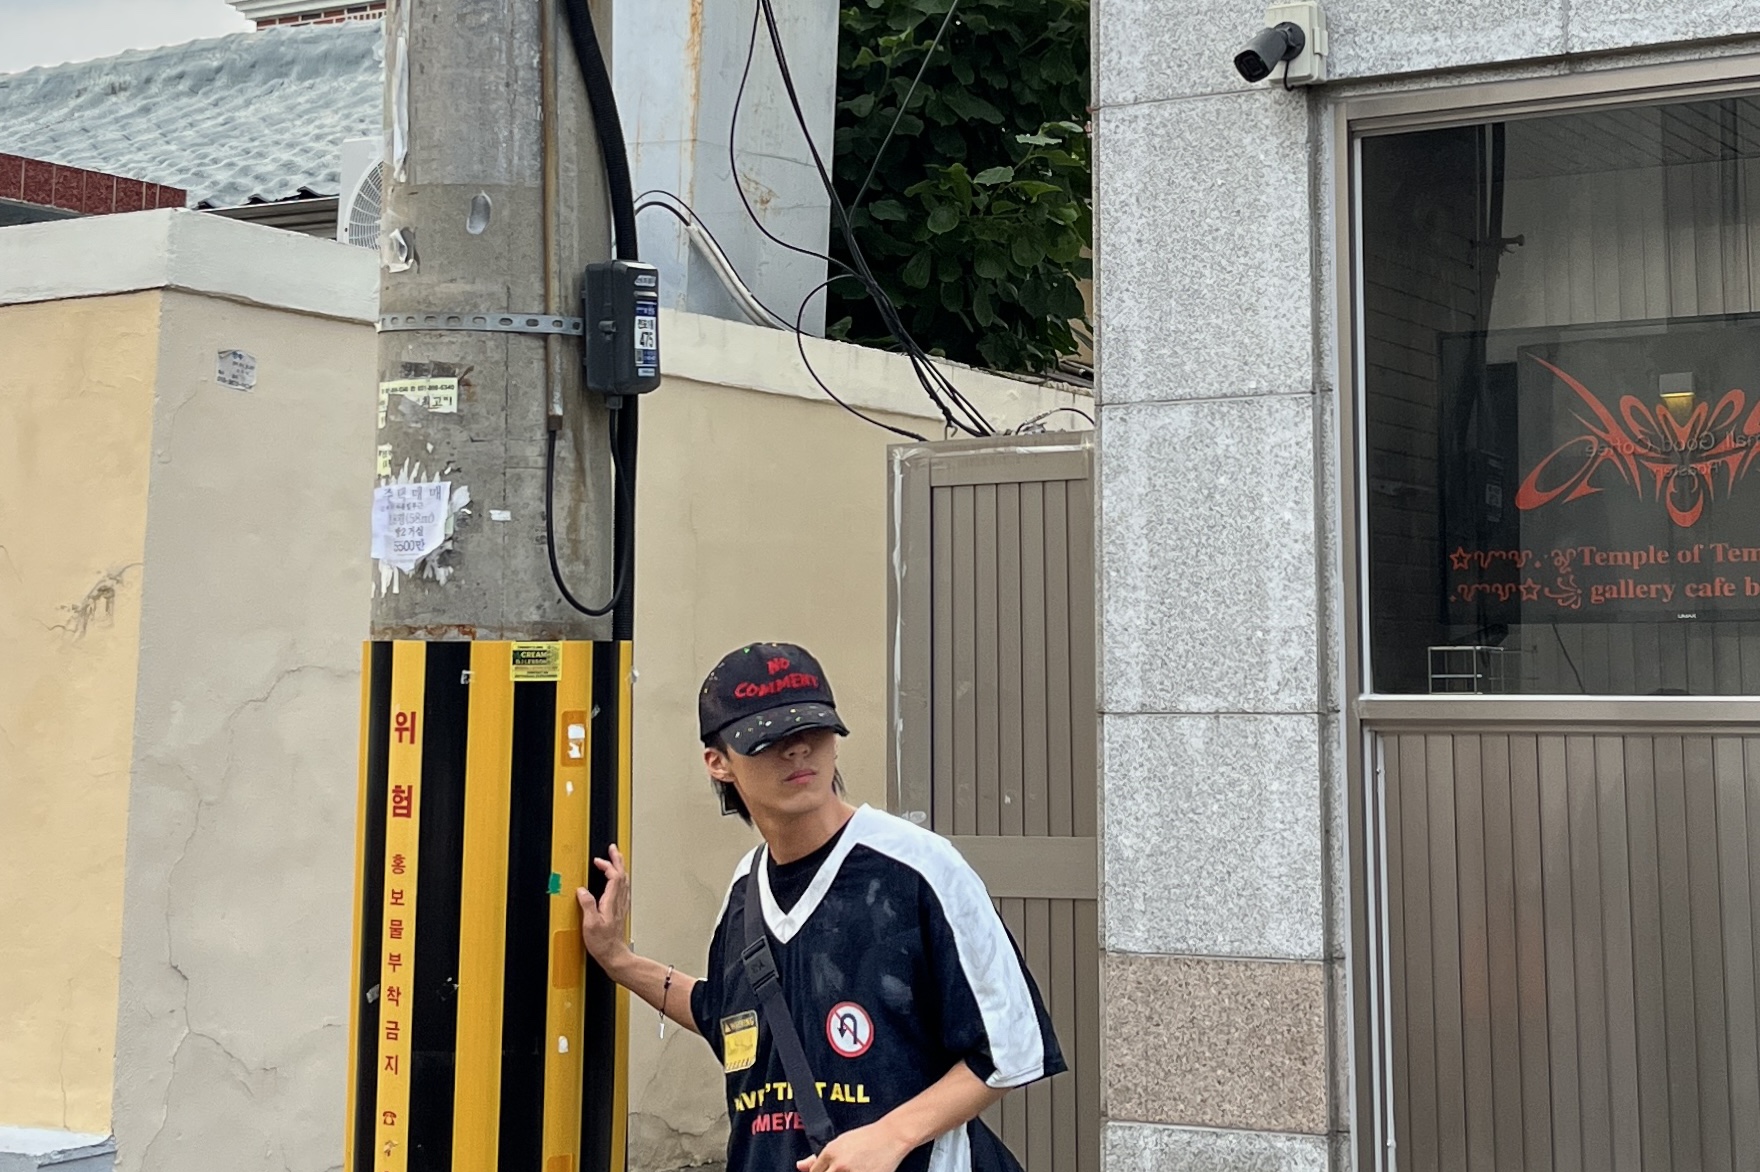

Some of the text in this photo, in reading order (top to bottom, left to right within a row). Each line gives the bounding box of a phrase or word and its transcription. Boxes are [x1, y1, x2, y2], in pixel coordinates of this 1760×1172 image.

[1577, 545, 1670, 570] Temple
[1677, 543, 1704, 564] of
[1591, 578, 1676, 604] gallery
[1684, 576, 1736, 598] cafe
[766, 657, 790, 675] NO
[734, 673, 819, 699] COMMENT
[392, 711, 417, 819] 위험
[830, 1084, 870, 1103] ALL
